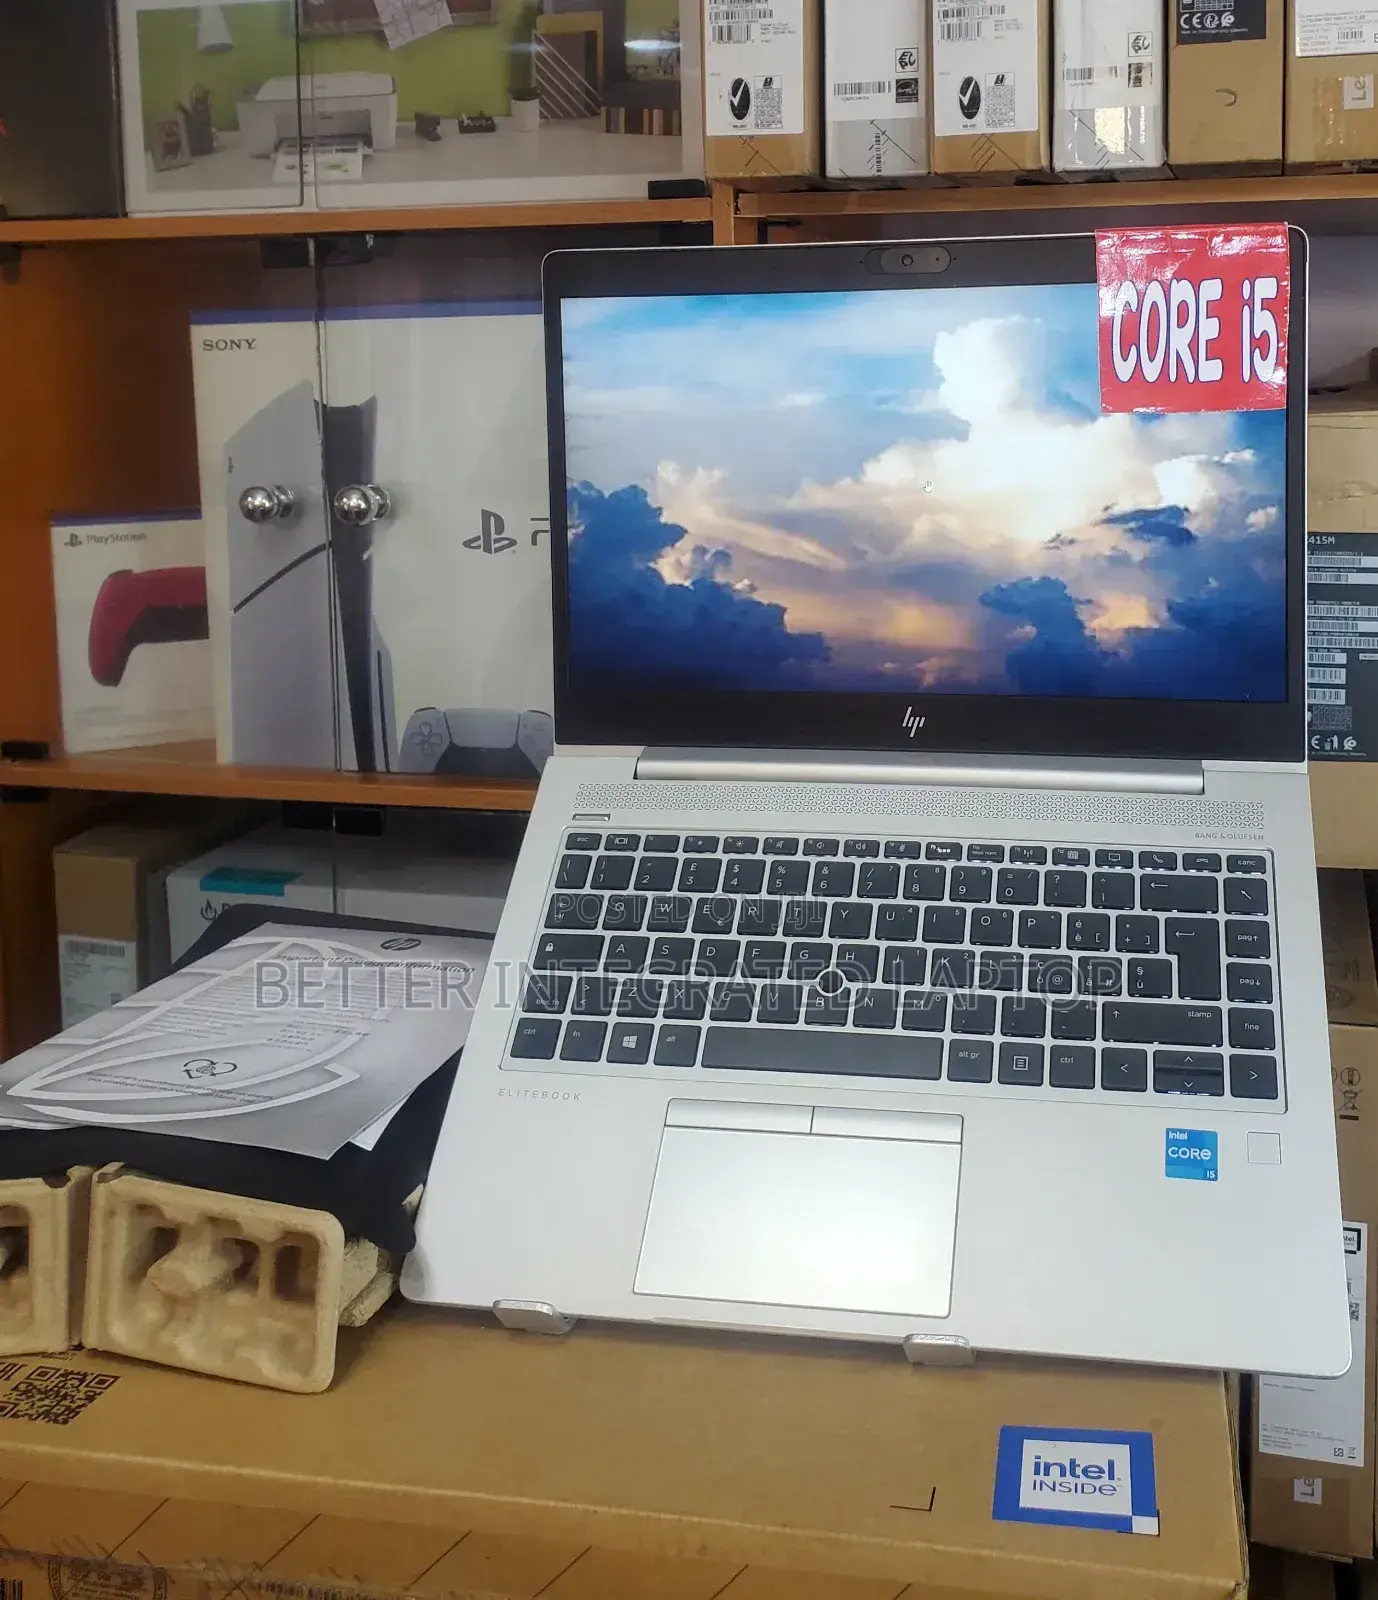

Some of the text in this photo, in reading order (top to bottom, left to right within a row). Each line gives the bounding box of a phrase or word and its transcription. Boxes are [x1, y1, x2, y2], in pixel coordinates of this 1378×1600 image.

[1112, 276, 1279, 384] CORE i5
[202, 338, 257, 352] SONY
[86, 532, 147, 546] PlayStation
[1307, 535, 1336, 545] 415M
[902, 706, 926, 738] hp
[642, 875, 650, 884] 2
[686, 876, 694, 885] 3
[731, 877, 738, 886] 4
[775, 879, 783, 888] 5
[820, 880, 828, 889] 6
[866, 882, 874, 890] 7
[912, 883, 920, 893] 8
[958, 885, 966, 894] 9
[703, 904, 711, 914] E
[841, 909, 849, 919] Y
[886, 911, 895, 920] U
[1027, 918, 1036, 928] P
[616, 943, 626, 954] A
[661, 945, 670, 954] S
[706, 947, 716, 957] D
[752, 949, 761, 958] F
[800, 950, 809, 959] G
[846, 952, 855, 962] H
[892, 954, 901, 964] J
[941, 956, 950, 967] K
[628, 987, 638, 997] Z
[674, 988, 684, 999] X
[815, 997, 825, 1007] B
[864, 997, 874, 1007] N
[1187, 1010, 1212, 1019] stamp
[1244, 1022, 1260, 1031] fine
[572, 1030, 580, 1038] fn
[665, 1035, 676, 1043] alt
[958, 1050, 980, 1059] alt gr
[1060, 1056, 1074, 1064] ctrl
[498, 1087, 581, 1100] ELITEBOOK
[1168, 1130, 1188, 1140] intel
[1033, 1455, 1115, 1481] intel
